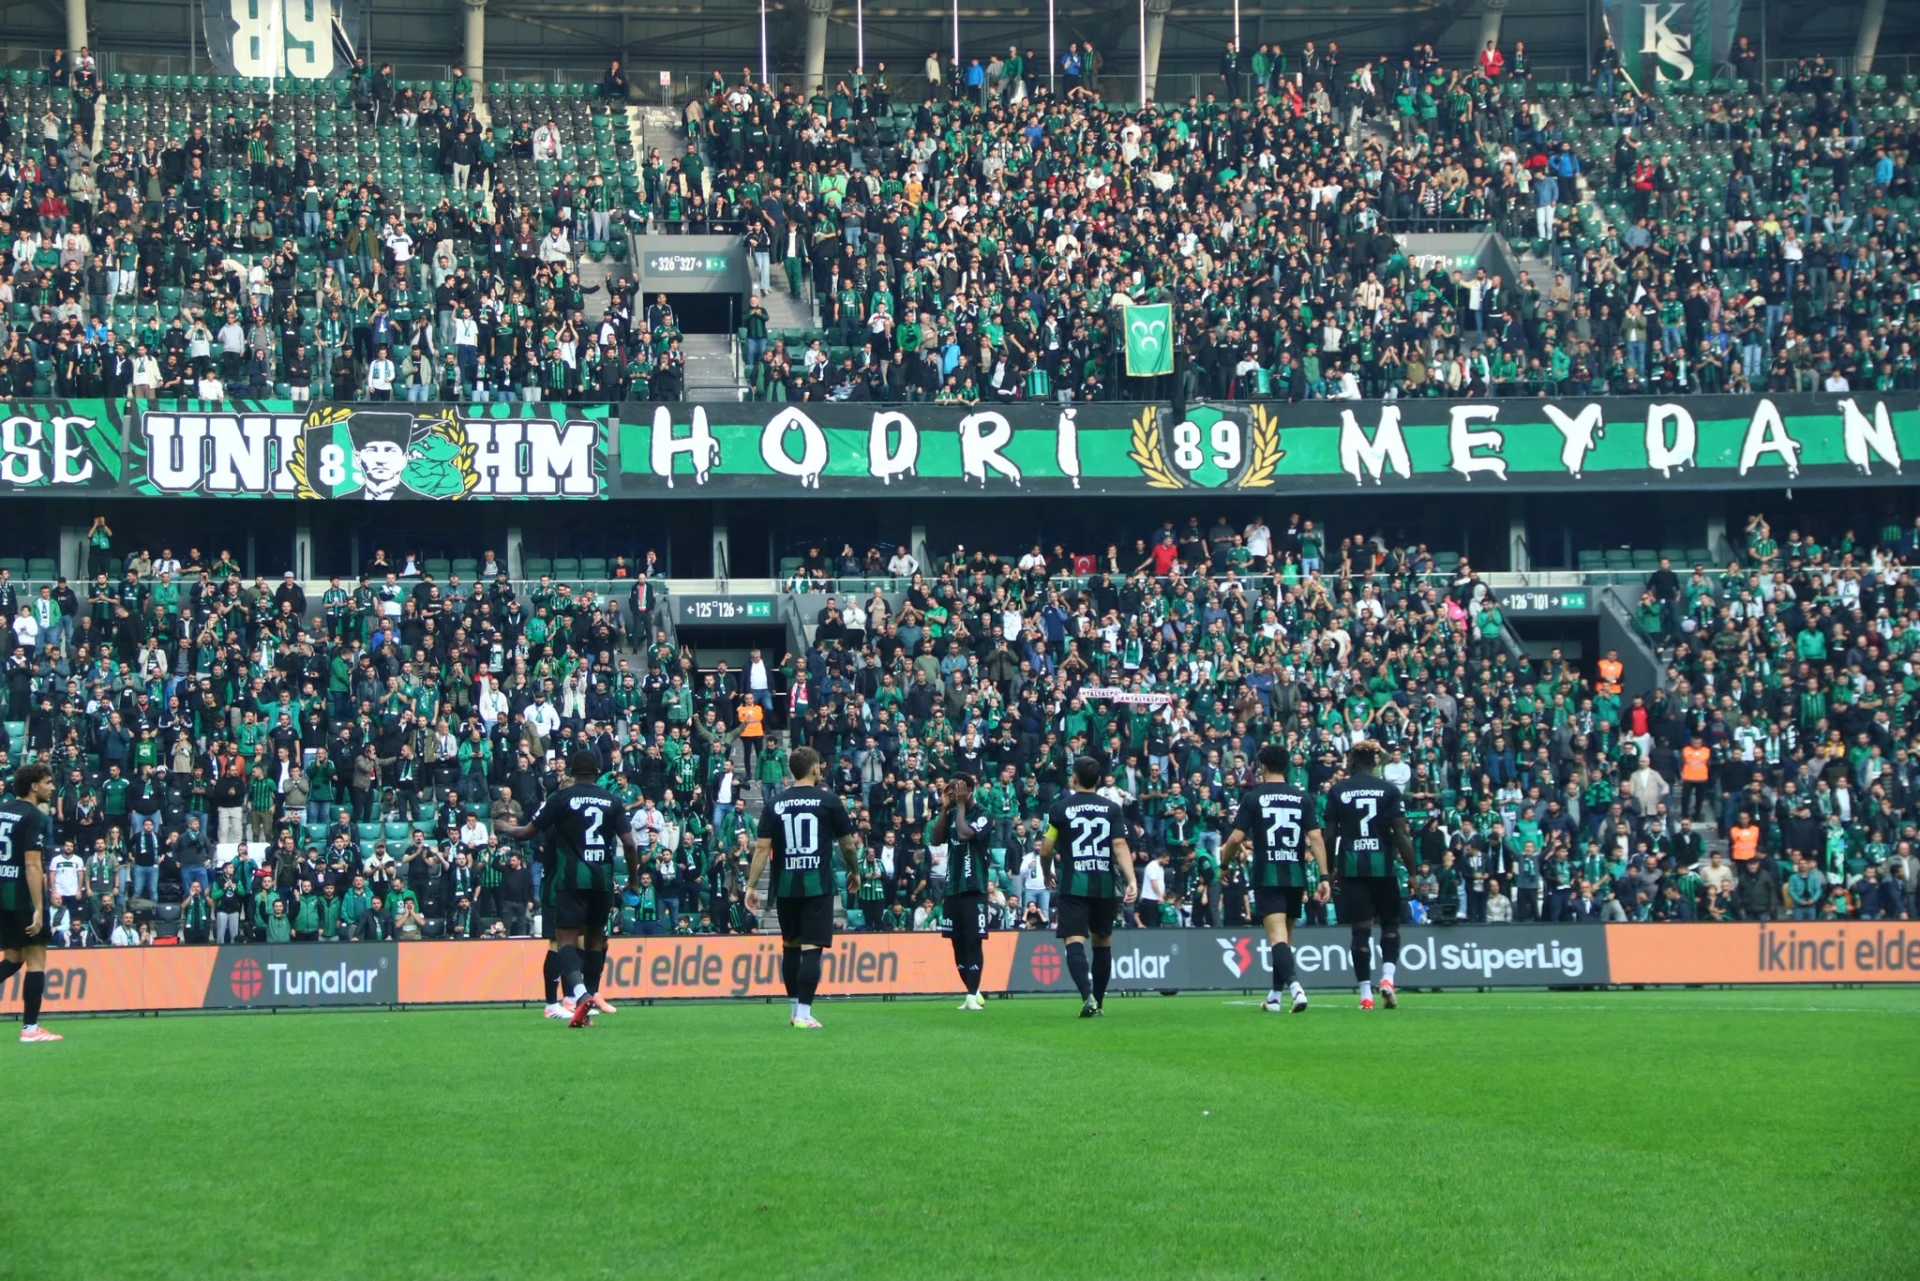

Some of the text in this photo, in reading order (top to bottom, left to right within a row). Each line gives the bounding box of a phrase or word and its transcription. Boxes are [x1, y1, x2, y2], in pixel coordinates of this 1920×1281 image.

[231, 0, 333, 78] 89
[658, 257, 696, 271] 326 327
[651, 400, 1902, 489] HODRI MEYDAN
[1173, 420, 1240, 469] 89
[696, 602, 735, 618] 125 126
[1510, 593, 1548, 610] 126 101
[575, 796, 612, 807] AUTOPORT
[779, 799, 821, 807] AUTOPORT
[1070, 804, 1109, 813] AUTOPORT
[1265, 794, 1302, 804] AUTOPORT
[1347, 790, 1384, 798] AUTOPORT
[584, 806, 605, 845] 2
[781, 813, 818, 855] 10
[1262, 807, 1302, 847] 75
[1356, 798, 1377, 837] 7
[1070, 817, 1110, 857] 22
[785, 856, 821, 870] LINETTY
[978, 913, 985, 928] 8
[1441, 940, 1583, 978] SüperLig
[1759, 921, 1920, 971] İkinci elde
[267, 962, 377, 995] Tunalar
[604, 945, 643, 987] nci
[651, 945, 723, 987] elde
